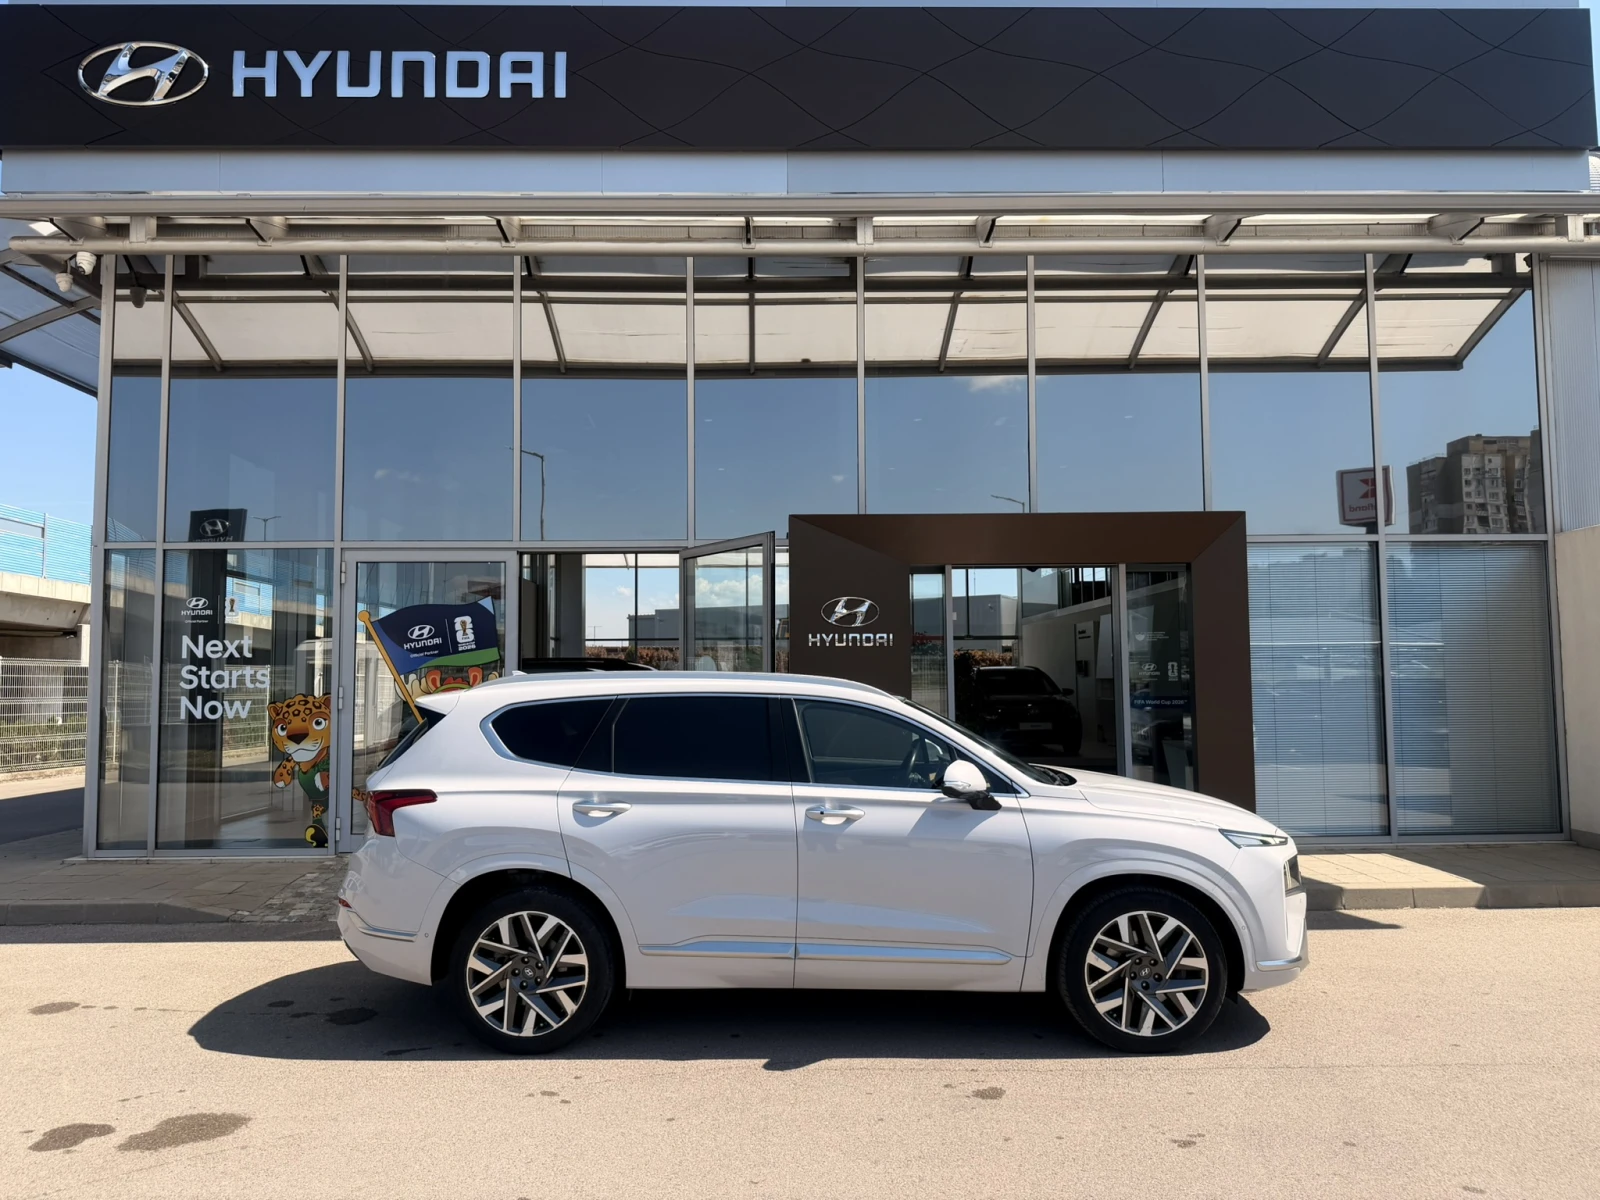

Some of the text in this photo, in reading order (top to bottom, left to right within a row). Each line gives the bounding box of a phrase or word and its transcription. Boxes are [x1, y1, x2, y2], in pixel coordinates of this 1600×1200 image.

[232, 50, 567, 99] HYUNDAI
[181, 635, 253, 659] Next
[403, 637, 442, 650] HYUNDAI
[808, 633, 893, 647] HYUNDAI
[179, 665, 271, 690] Starts
[180, 696, 252, 720] Now
